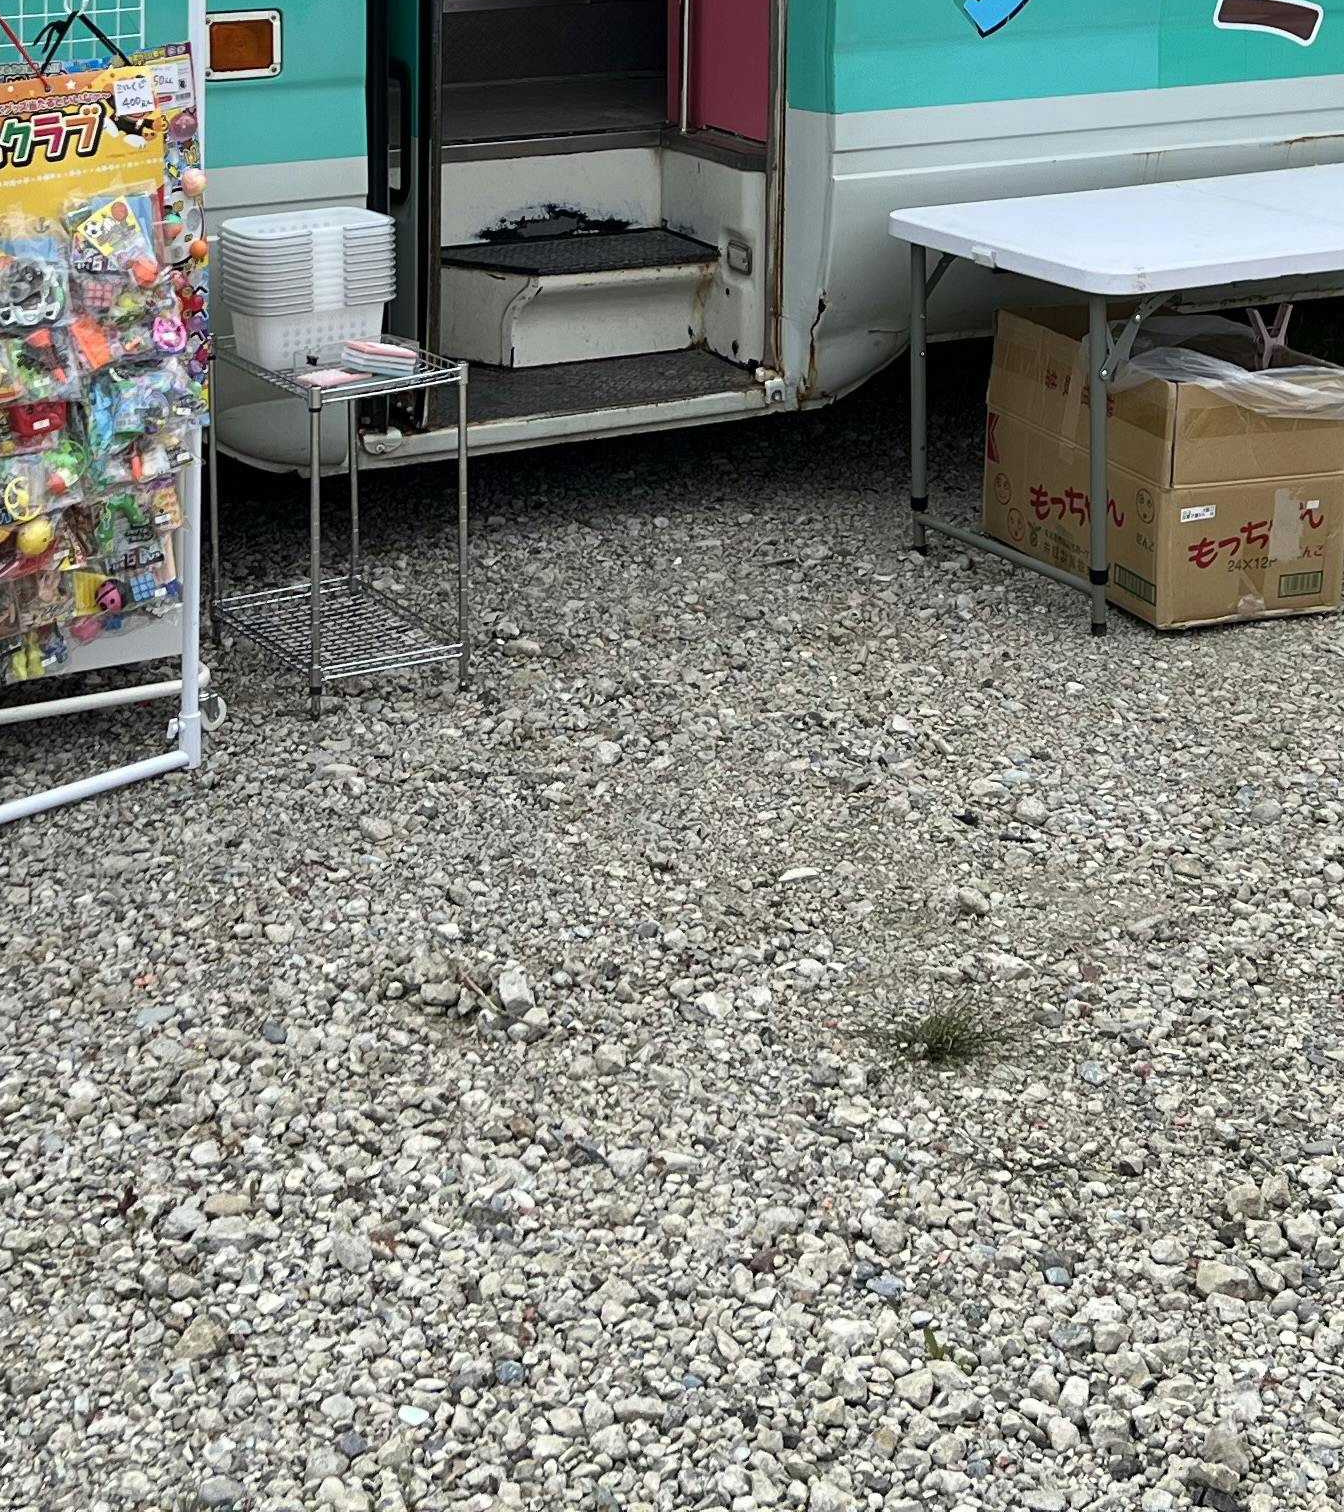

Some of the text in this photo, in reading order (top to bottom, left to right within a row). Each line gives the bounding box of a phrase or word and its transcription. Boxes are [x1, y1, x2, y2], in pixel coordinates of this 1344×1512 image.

[1029, 484, 1125, 527] もっちん
[1188, 499, 1324, 569] もっちん
